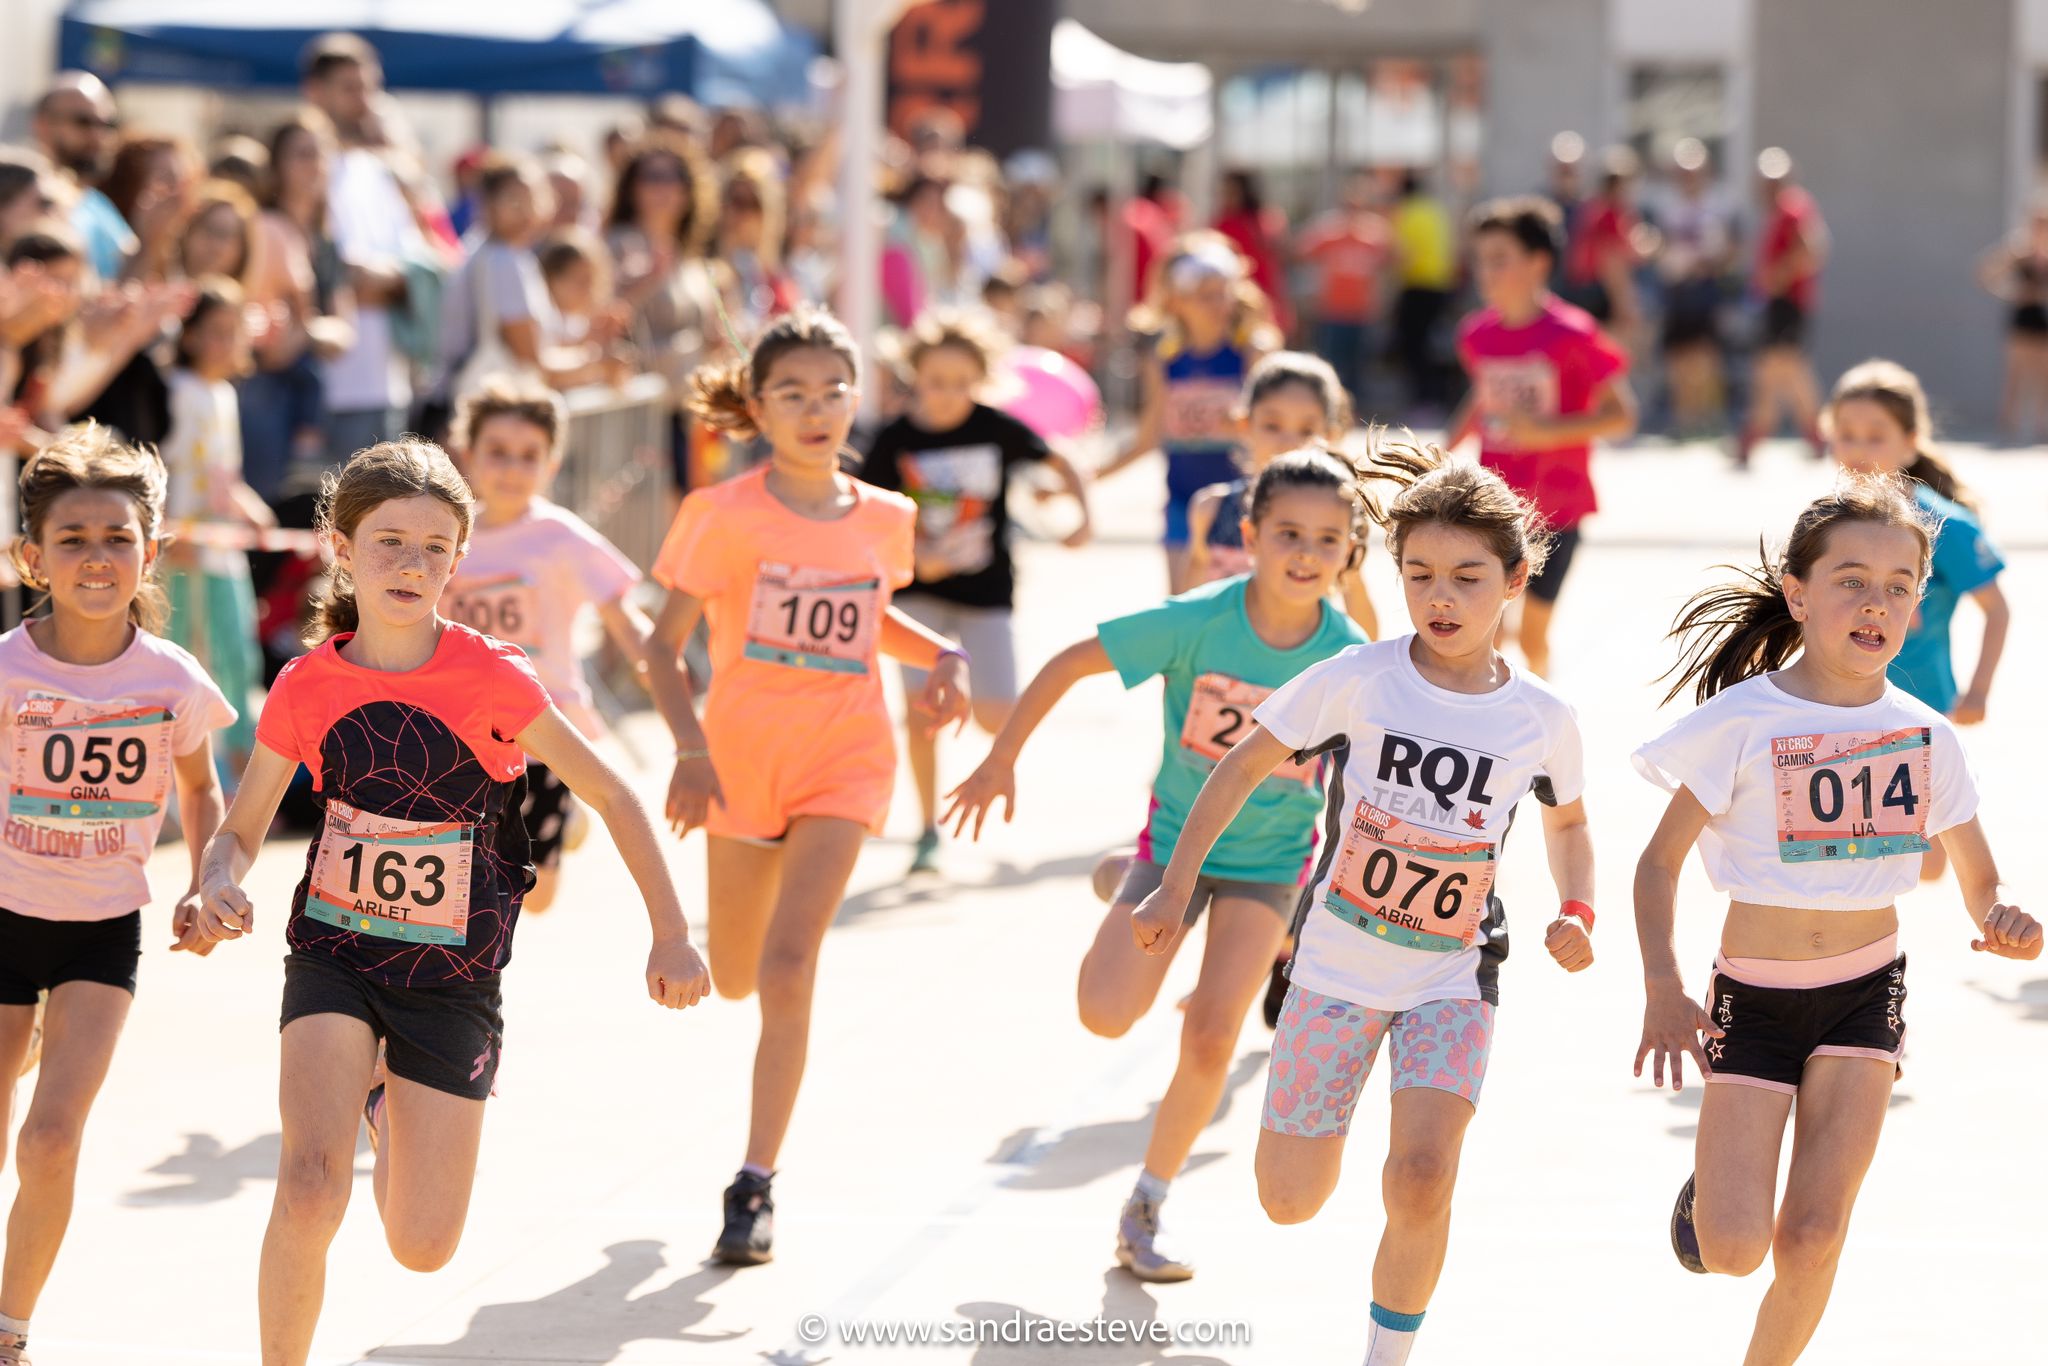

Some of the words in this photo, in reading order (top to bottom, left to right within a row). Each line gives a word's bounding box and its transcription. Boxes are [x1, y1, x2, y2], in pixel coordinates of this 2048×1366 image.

[780, 593, 860, 644] 109
[17, 714, 53, 729] CAMINS
[1788, 737, 1814, 750] CROS
[42, 733, 148, 785] 059
[1777, 753, 1815, 768] CAMINS
[1376, 733, 1494, 812] RQL
[70, 786, 112, 801] GINA
[1372, 786, 1458, 826] TEAM
[1809, 763, 1920, 824] 014
[328, 814, 351, 835] CAMINS
[1358, 802, 1368, 817] XI
[1367, 807, 1391, 828] CROS
[3, 818, 85, 860] FOLLOW
[1354, 816, 1386, 842] CAMINS
[1852, 822, 1878, 837] LIA
[343, 842, 446, 907] 163
[1362, 848, 1469, 920] 076
[352, 899, 412, 922] ARLET
[1375, 905, 1426, 932] ABRIL
